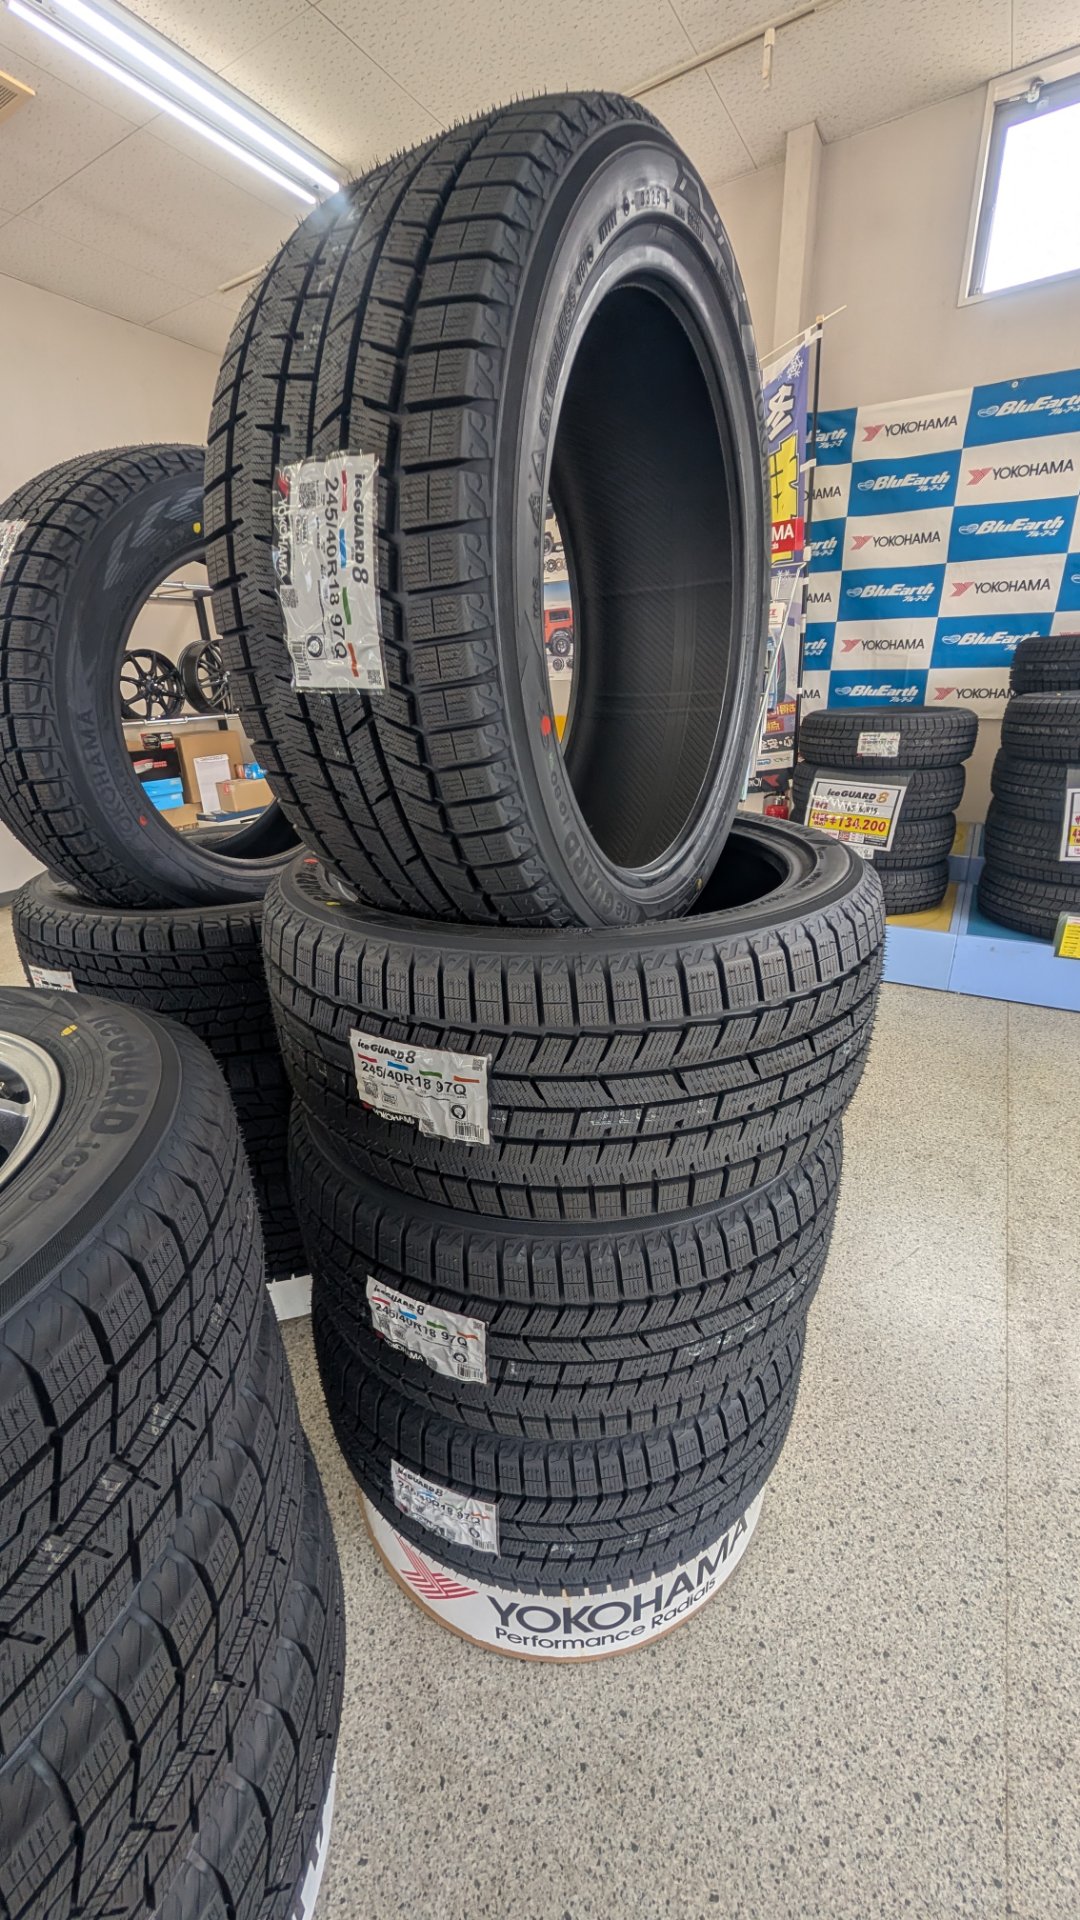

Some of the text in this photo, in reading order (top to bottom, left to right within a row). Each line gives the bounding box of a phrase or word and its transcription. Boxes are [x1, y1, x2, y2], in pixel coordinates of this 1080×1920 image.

[884, 415, 959, 437] YOKOHAMA
[992, 459, 1074, 480] YOKOHAMA
[873, 471, 951, 491] BluEarth
[351, 473, 369, 585] iceGUARD 8
[975, 516, 1064, 535] BluEarth
[277, 498, 290, 578] YOKOHAMA
[873, 531, 941, 548] YOKOHAMA
[324, 477, 348, 660] 245/40R18 97Q
[860, 583, 935, 598] BluEarth
[975, 578, 1051, 595] YOKOHAMA
[861, 638, 925, 651] YOKOHAMA
[849, 685, 919, 697] BluEarth
[827, 788, 889, 803] iceGUARD 8
[357, 1038, 416, 1064] iceGUARD 8
[361, 1061, 432, 1090] 245/40R18
[436, 1080, 467, 1096] 97Q
[416, 1304, 425, 1316] 8
[375, 1303, 468, 1347] 245/40R18 97Q
[487, 1514, 748, 1635] YOKOHAMA
[495, 1577, 716, 1650] Performance Radials
